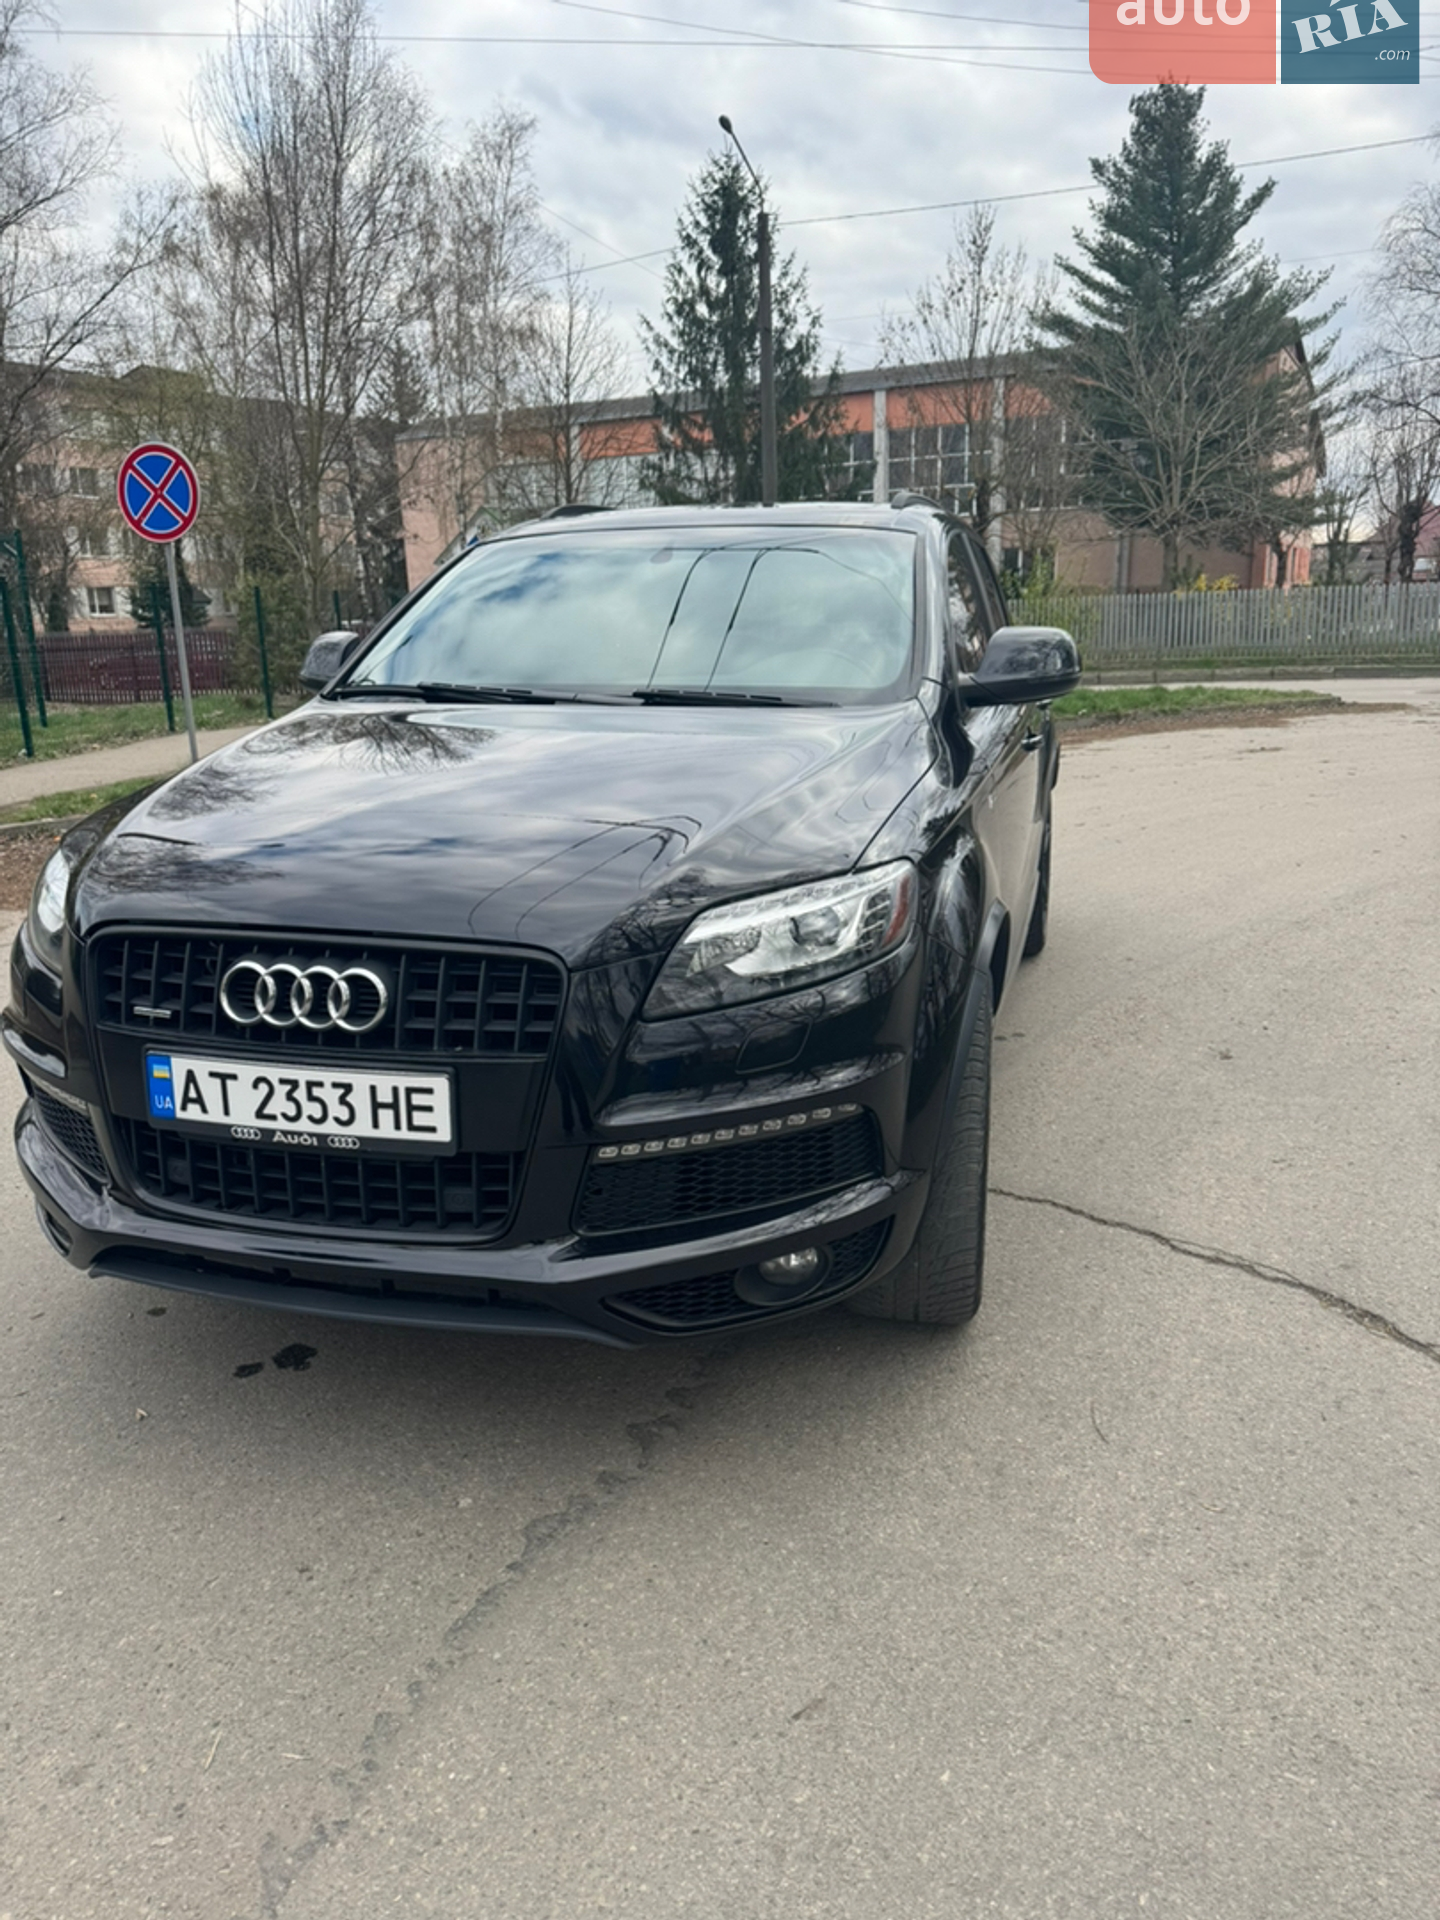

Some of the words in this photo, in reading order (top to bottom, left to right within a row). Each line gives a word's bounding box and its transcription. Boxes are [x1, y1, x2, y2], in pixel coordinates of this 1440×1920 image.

[154, 1094, 174, 1111] UA
[179, 1068, 239, 1117] AT
[251, 1076, 356, 1128] 2353
[369, 1084, 438, 1134] HE
[271, 1130, 319, 1147] Audi
